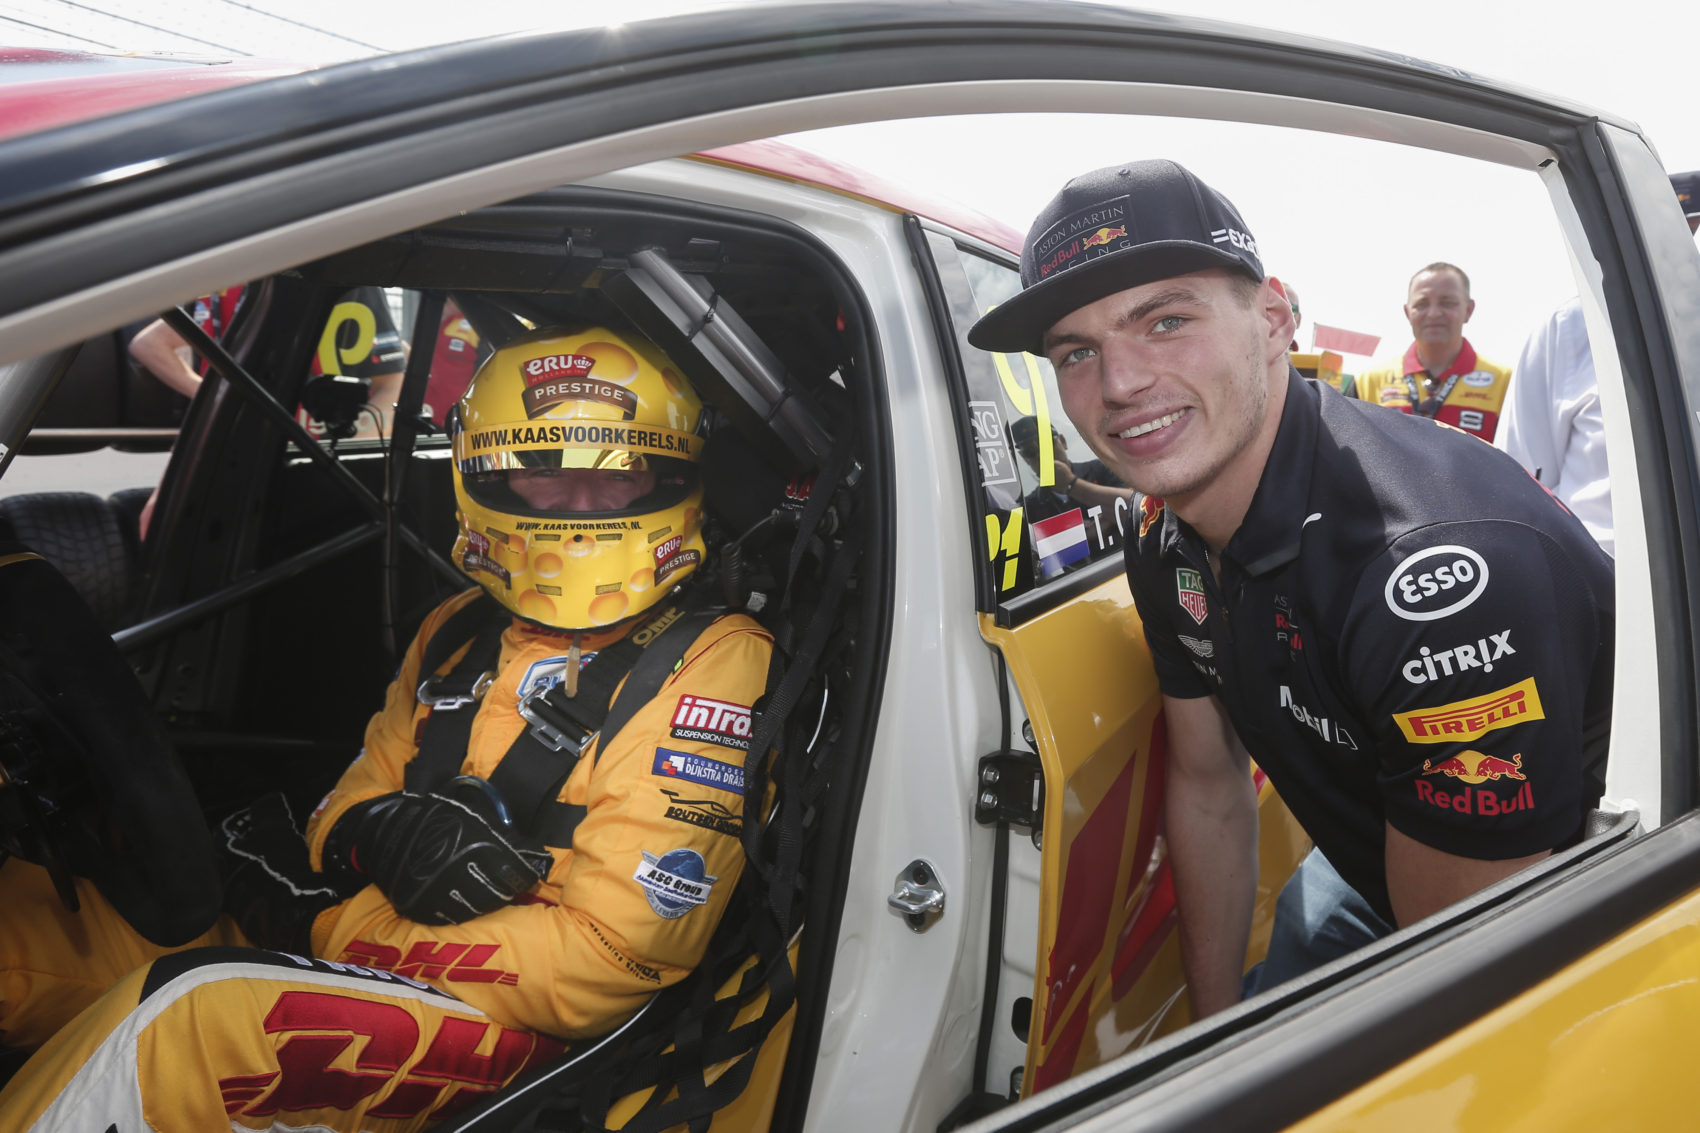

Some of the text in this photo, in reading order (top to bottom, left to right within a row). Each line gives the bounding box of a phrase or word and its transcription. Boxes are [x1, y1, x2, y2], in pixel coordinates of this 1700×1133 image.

[1070, 205, 1125, 232] MARTIN
[1057, 239, 1081, 264] Bull
[534, 382, 625, 401] PRESTIGE
[470, 426, 692, 454] WWW.KAASVOORKERELS.NL
[1087, 504, 1115, 551] T.
[660, 551, 696, 575] PRESTIGE
[1181, 592, 1207, 619] HEUE
[1407, 689, 1528, 738] PIRELLI
[674, 728, 722, 744] SUSPENSION
[1415, 779, 1536, 817] Red Bull
[647, 869, 674, 886] ASC
[673, 879, 703, 897] Group
[343, 939, 519, 986] DHL
